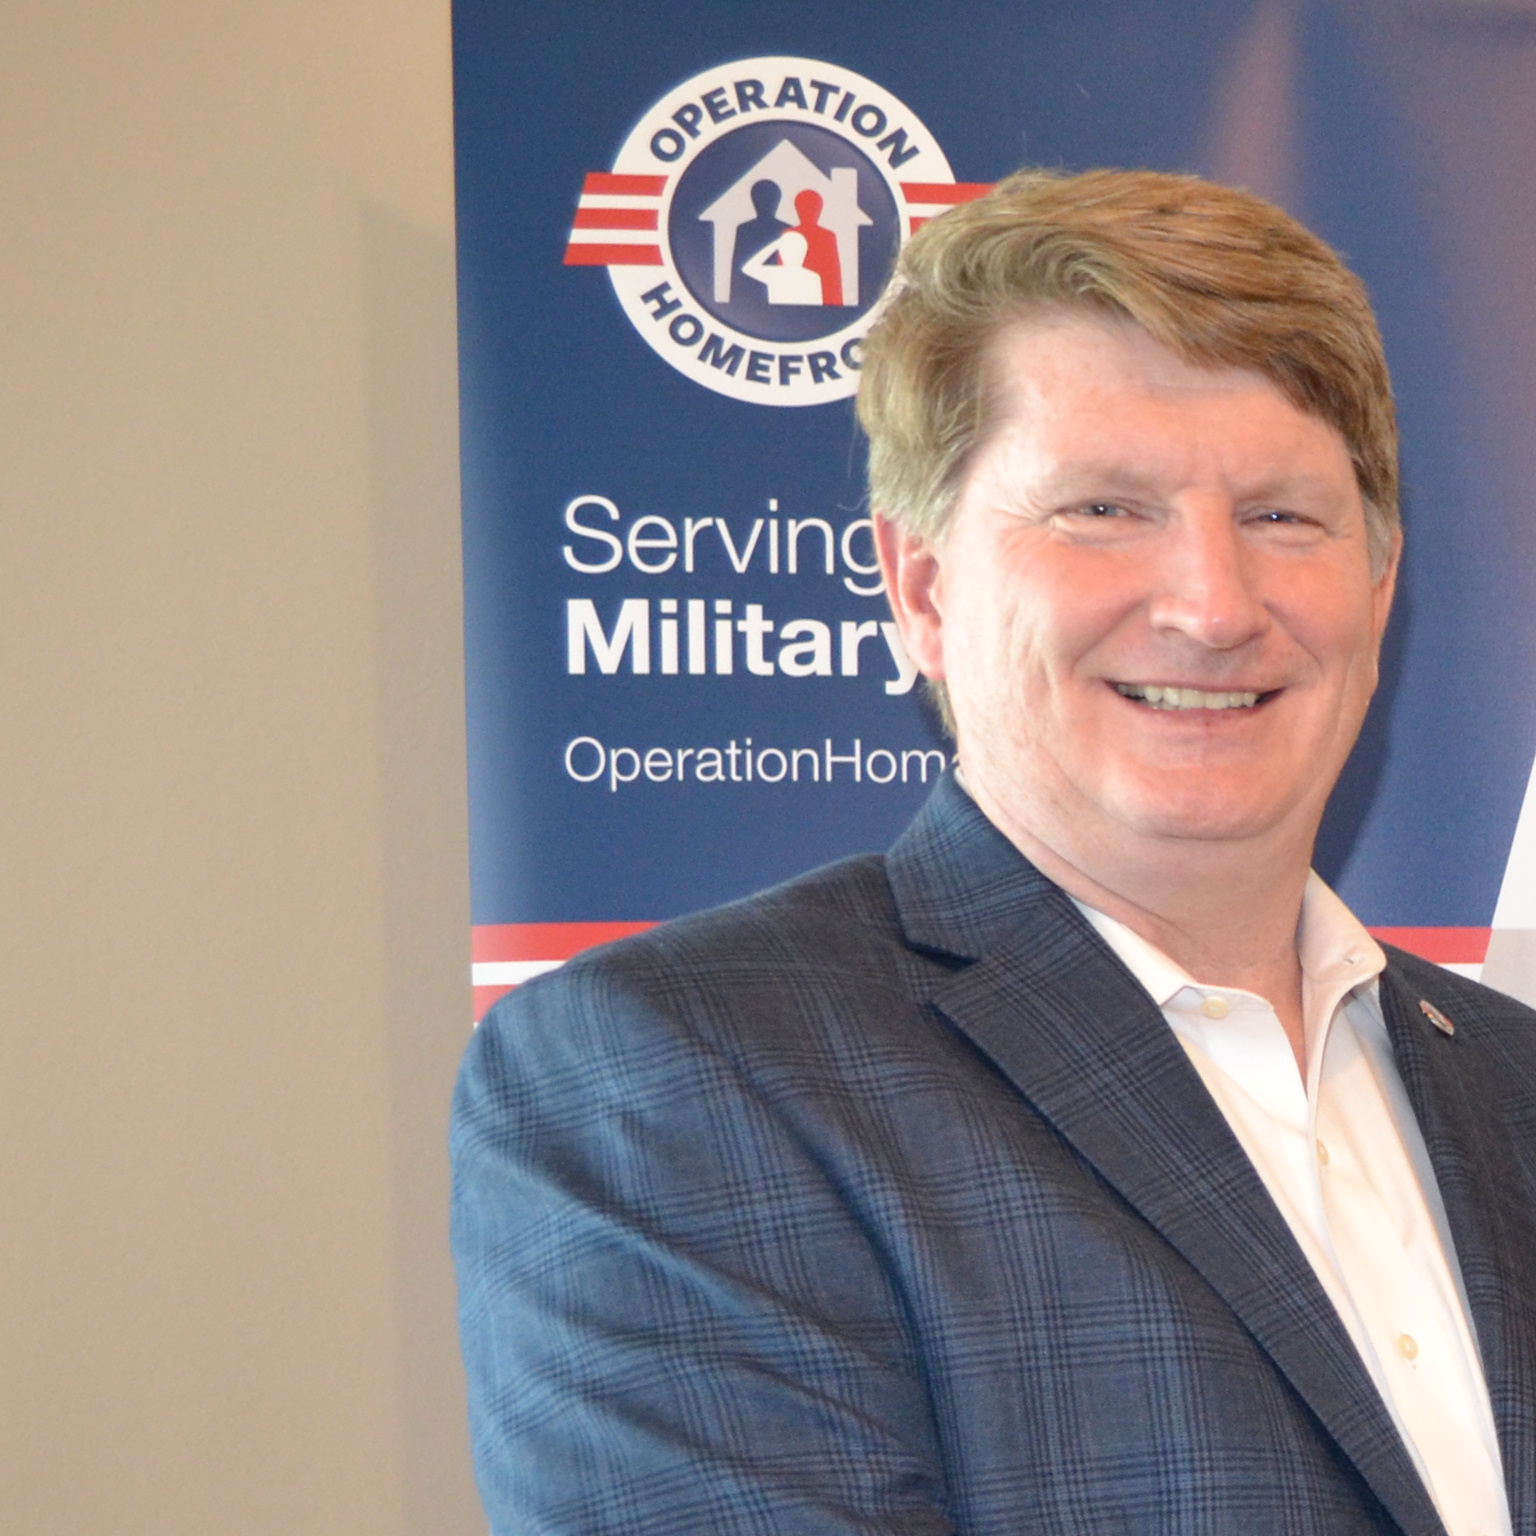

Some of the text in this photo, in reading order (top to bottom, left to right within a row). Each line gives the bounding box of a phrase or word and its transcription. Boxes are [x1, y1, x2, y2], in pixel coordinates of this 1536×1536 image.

[649, 77, 919, 169] OPERATION
[563, 494, 884, 596] Serving
[567, 598, 918, 695] Military
[564, 735, 960, 792] OperationHom
